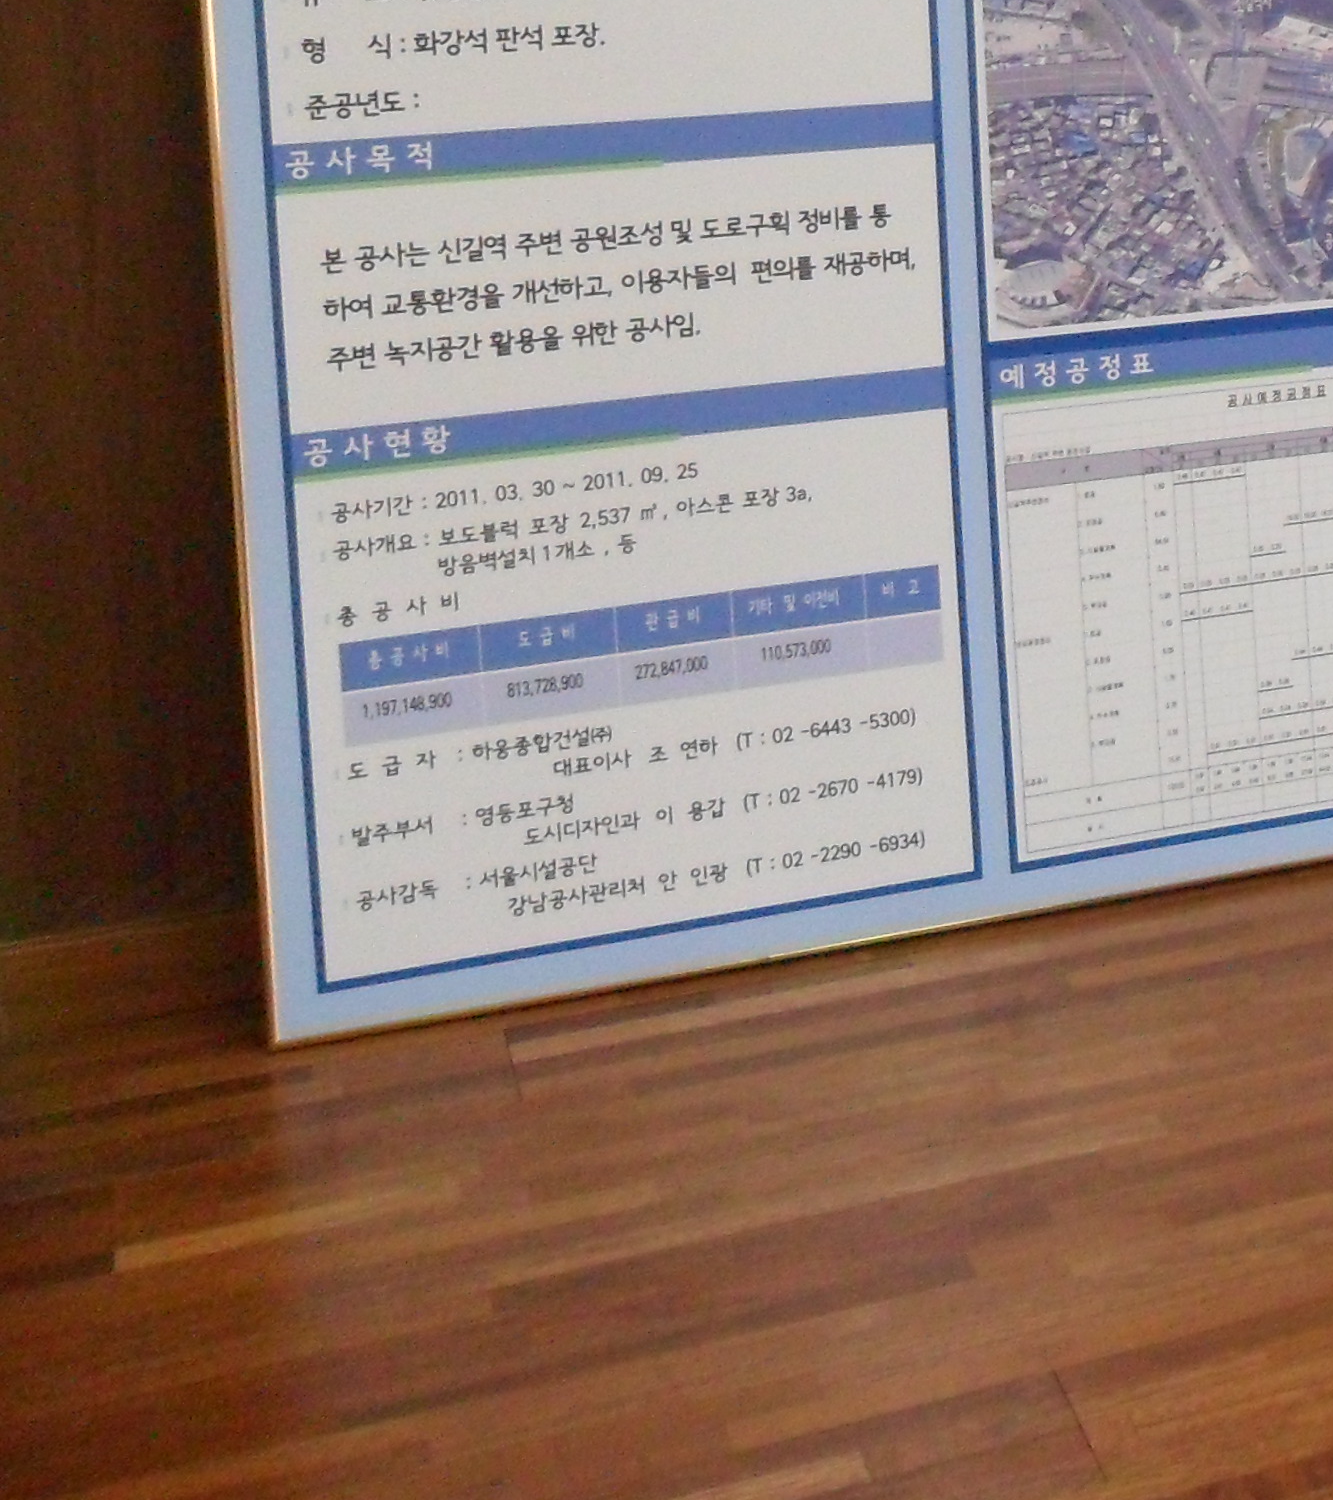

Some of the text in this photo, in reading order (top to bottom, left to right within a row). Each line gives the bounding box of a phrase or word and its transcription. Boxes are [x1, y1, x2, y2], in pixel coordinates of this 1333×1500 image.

[413, 27, 488, 57] 화강석
[495, 24, 543, 53] 판석
[551, 21, 606, 49] 포장.
[284, 140, 433, 180] 공사목적
[319, 203, 892, 275] 본 공사는 신길역 주변 공원조성 및 도로구획 정비를 통
[322, 246, 916, 322] 하여 교통환경을 개선하고, 이용자들의 편의를 재공하며,
[326, 311, 701, 373] 주변 녹지공간 활용을 위한 공사임.
[999, 352, 1155, 390] 예정공정표
[303, 424, 451, 468] 공사현황
[330, 462, 699, 524] 공사기간 2011. 03. 30 2011. 09. 25
[332, 533, 417, 562] 공사개요
[438, 519, 519, 547] 보도블럭
[528, 513, 570, 535] 포장
[579, 506, 631, 530] 2,537
[675, 493, 735, 517] 아스콘
[742, 486, 780, 508] 포장
[437, 545, 536, 577] 방음벽설치
[617, 533, 637, 555] 등
[552, 749, 632, 777] 대표이사
[648, 745, 669, 764] 조
[679, 735, 719, 761] 연하
[771, 725, 795, 744] 02
[800, 717, 852, 739] -6443
[859, 707, 916, 730] -5300)
[351, 792, 574, 848] 발주부서 영등포구청
[523, 810, 641, 846] 도시디자인과
[655, 805, 673, 826] 이
[687, 797, 726, 822] 용갑
[779, 786, 801, 805] 02
[808, 777, 859, 800] -2670
[866, 767, 923, 789] -4179)
[356, 852, 598, 912] 공사감독 서울시설공단
[508, 875, 646, 917] 강남공사관리처
[657, 870, 678, 893] 안
[690, 862, 729, 887] 인광
[781, 850, 804, 870] 02
[810, 841, 862, 863] -2290
[869, 830, 926, 853] -6934)
